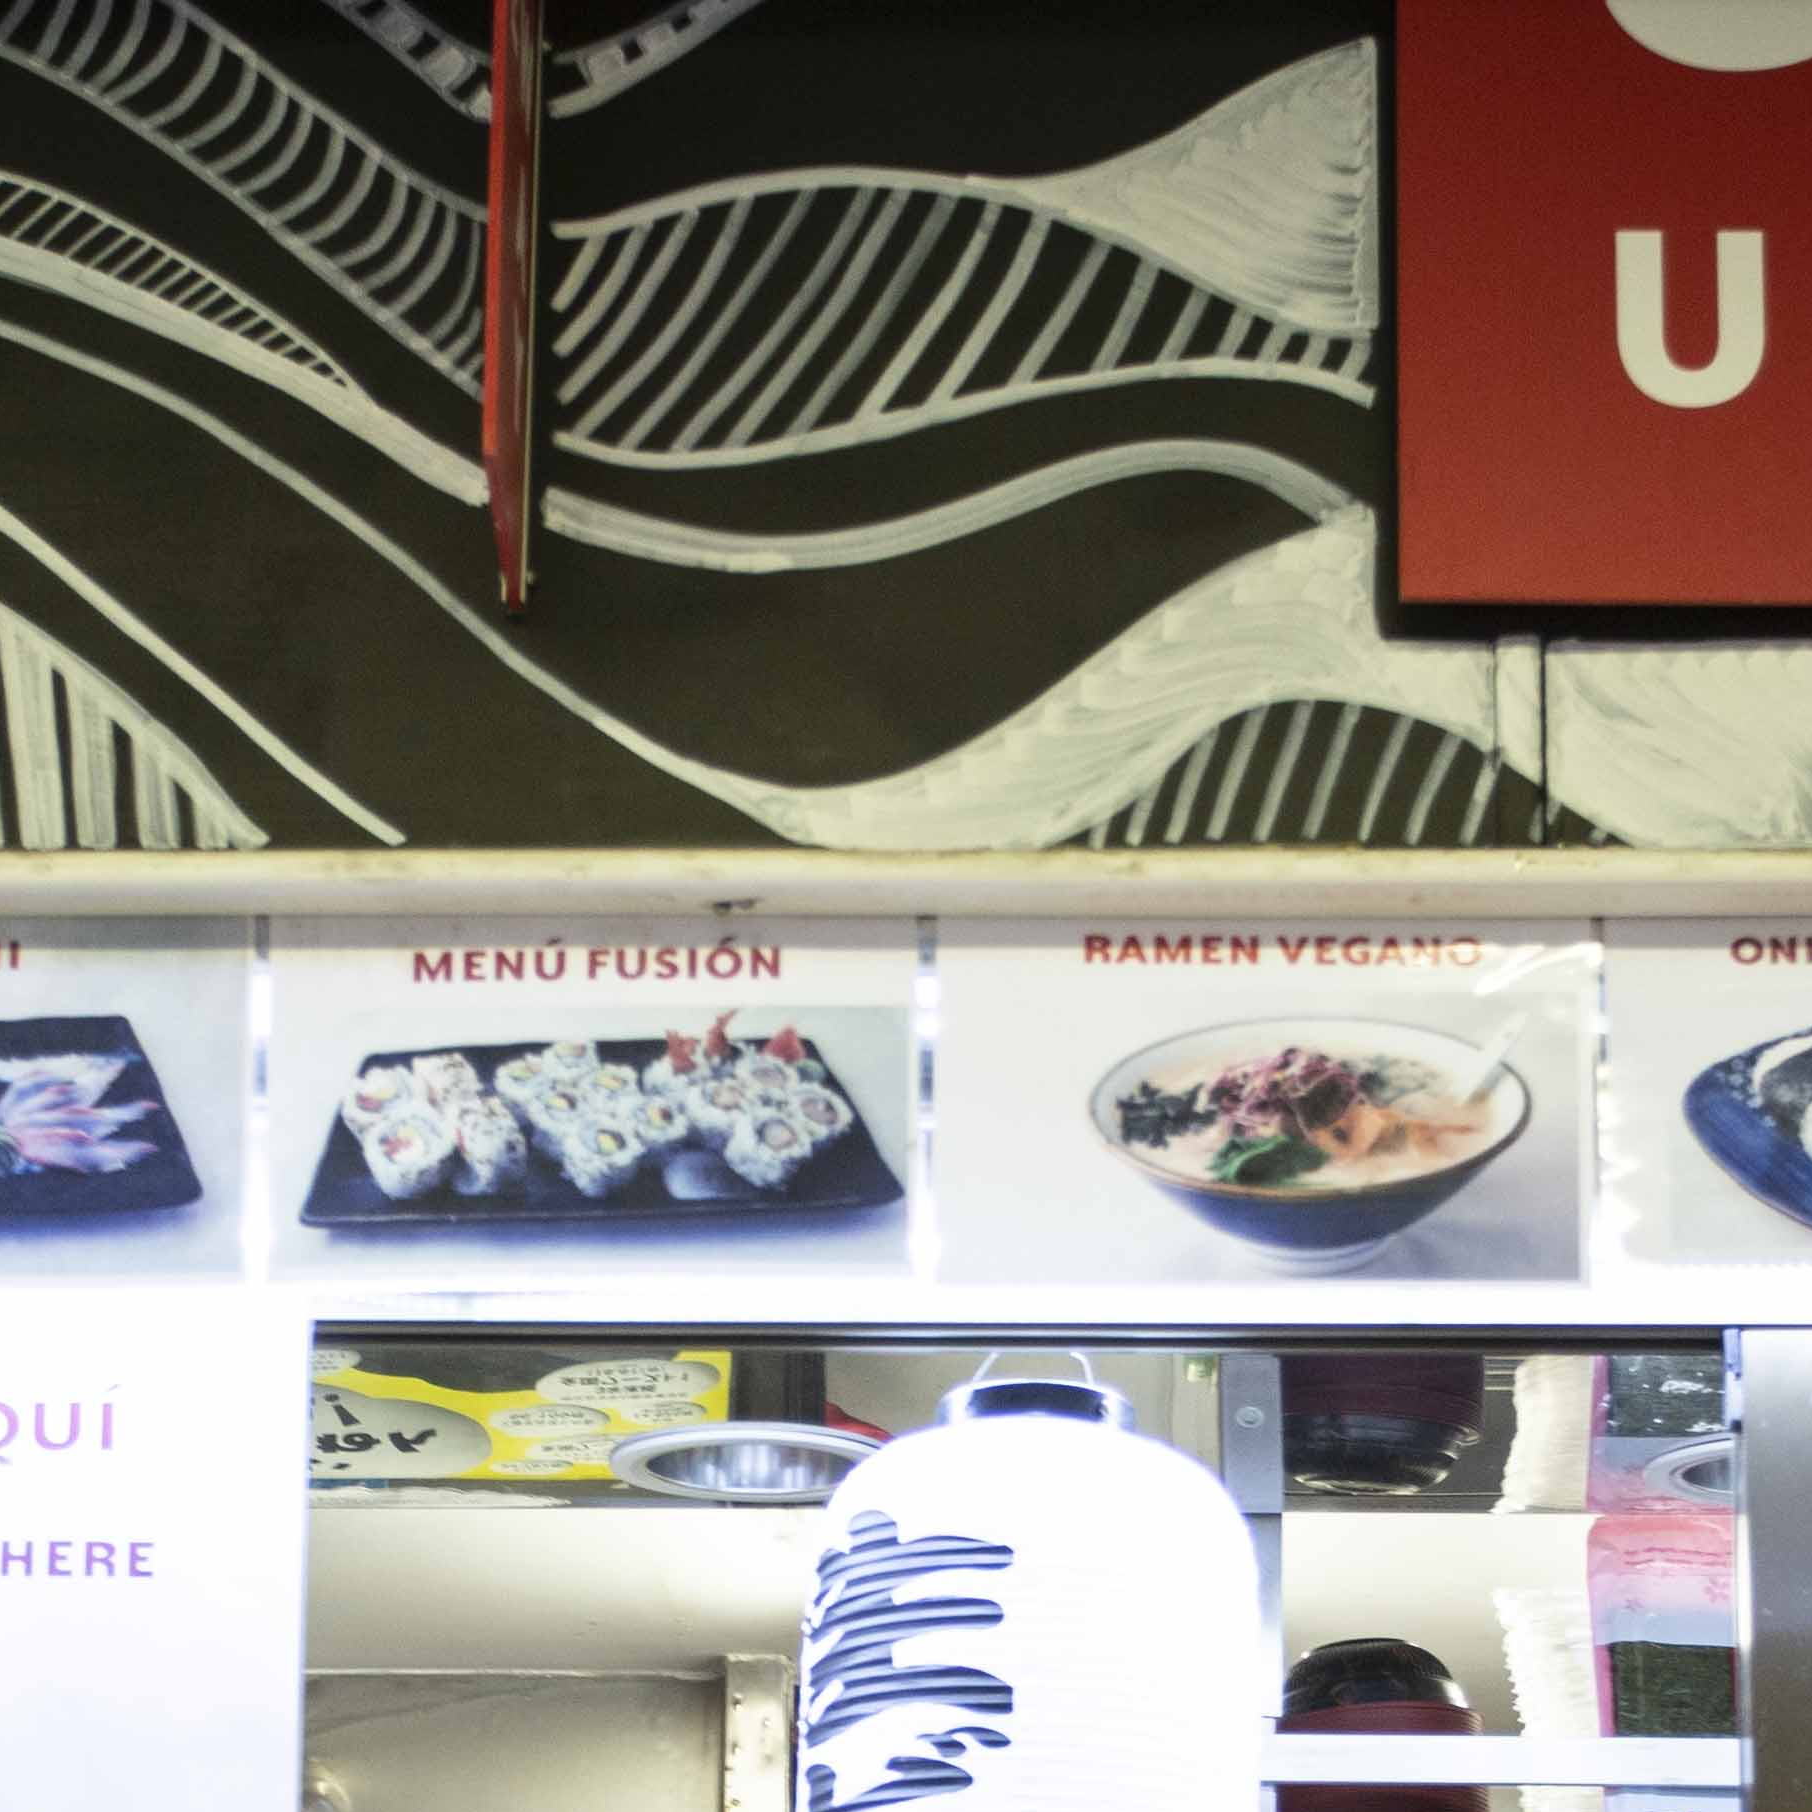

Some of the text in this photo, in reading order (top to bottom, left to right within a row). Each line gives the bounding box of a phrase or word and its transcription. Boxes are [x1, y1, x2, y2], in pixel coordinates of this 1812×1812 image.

[411, 936, 783, 983] MENÚ FUSIÓN
[1083, 934, 1484, 967] RAMEN VEGANO
[0, 1541, 154, 1578] HERE
